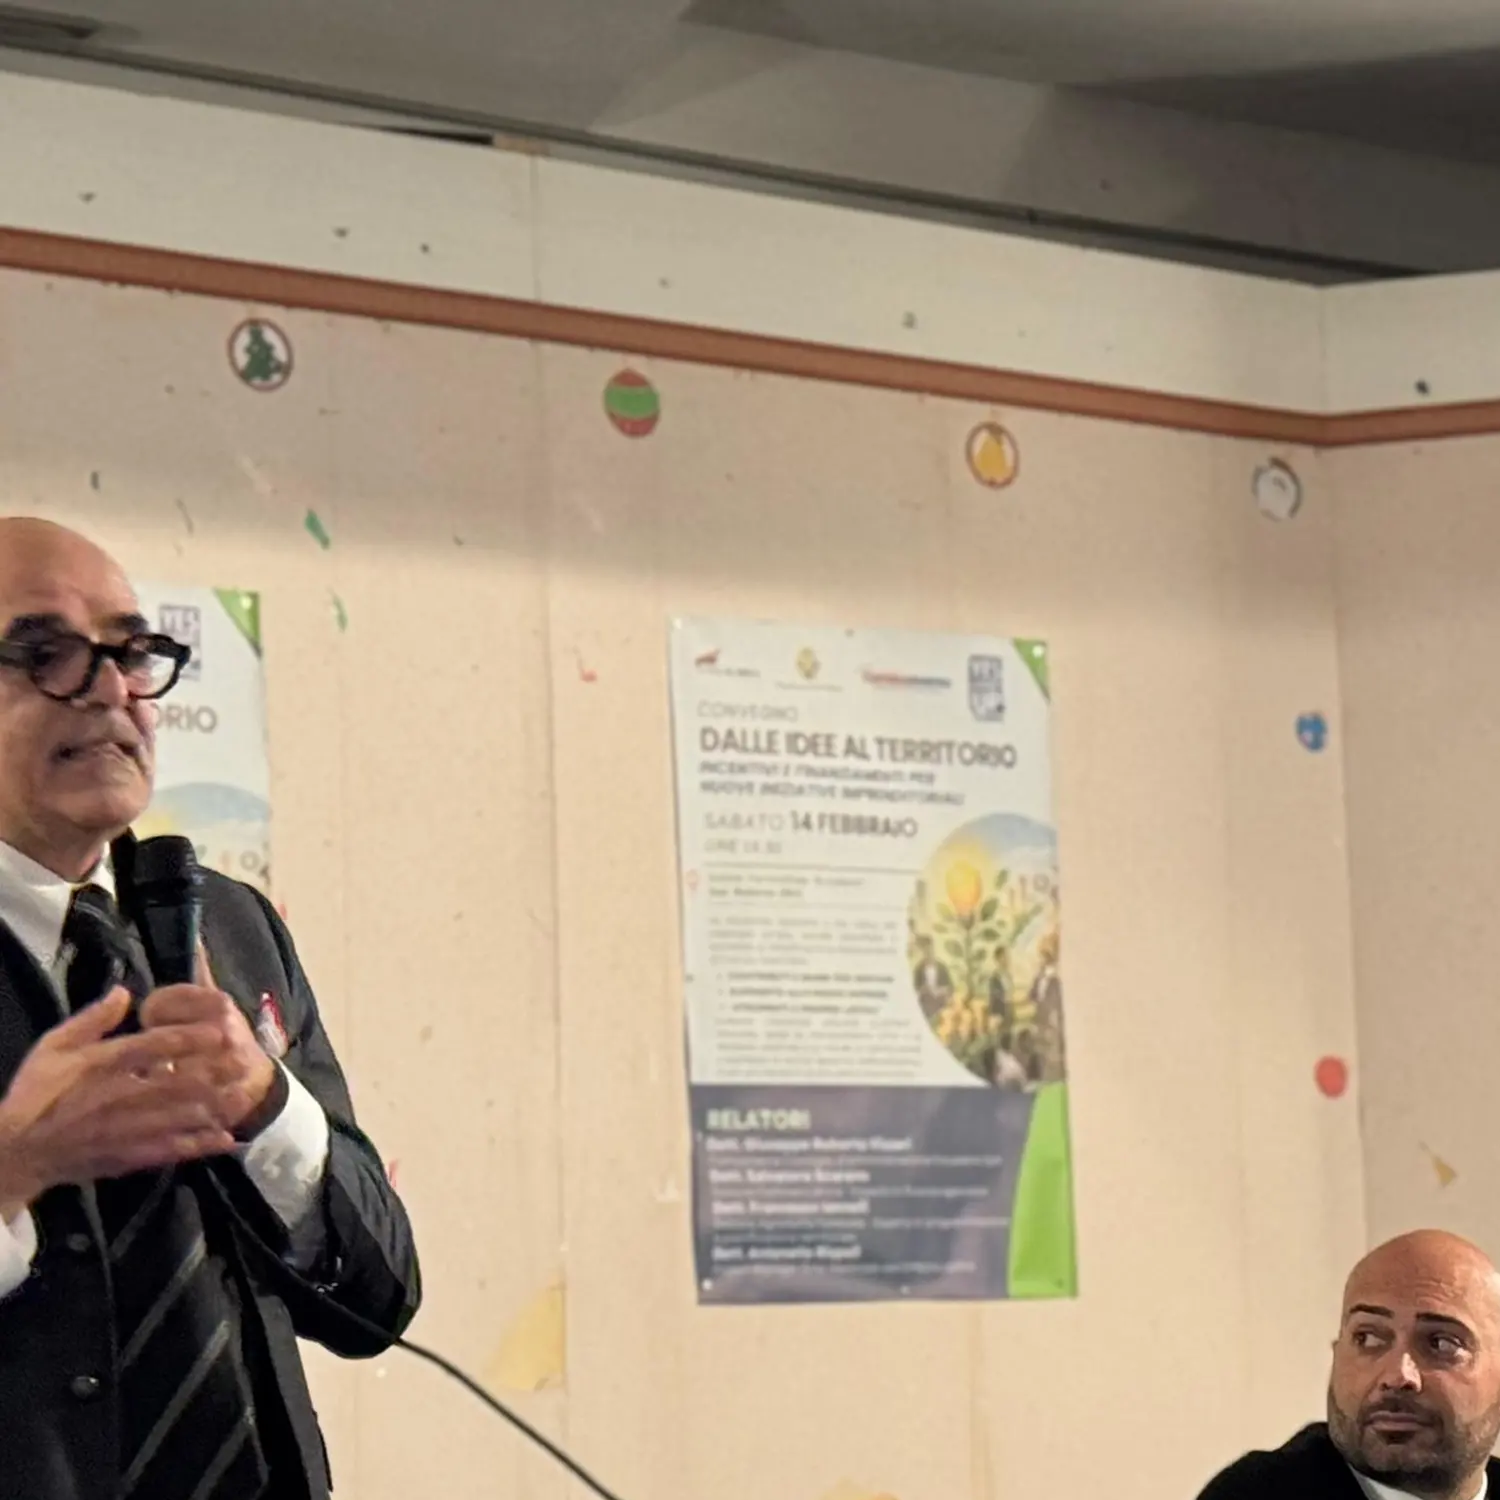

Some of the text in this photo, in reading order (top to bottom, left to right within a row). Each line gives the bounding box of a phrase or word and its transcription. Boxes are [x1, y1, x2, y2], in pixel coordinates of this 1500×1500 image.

[699, 701, 798, 721] CONVEGNO
[700, 727, 1017, 768] DALLE IDEE AL TERRITORIO
[704, 811, 918, 837] SABATO 14 FEBBRAIO
[707, 1109, 811, 1130] RELATORI
